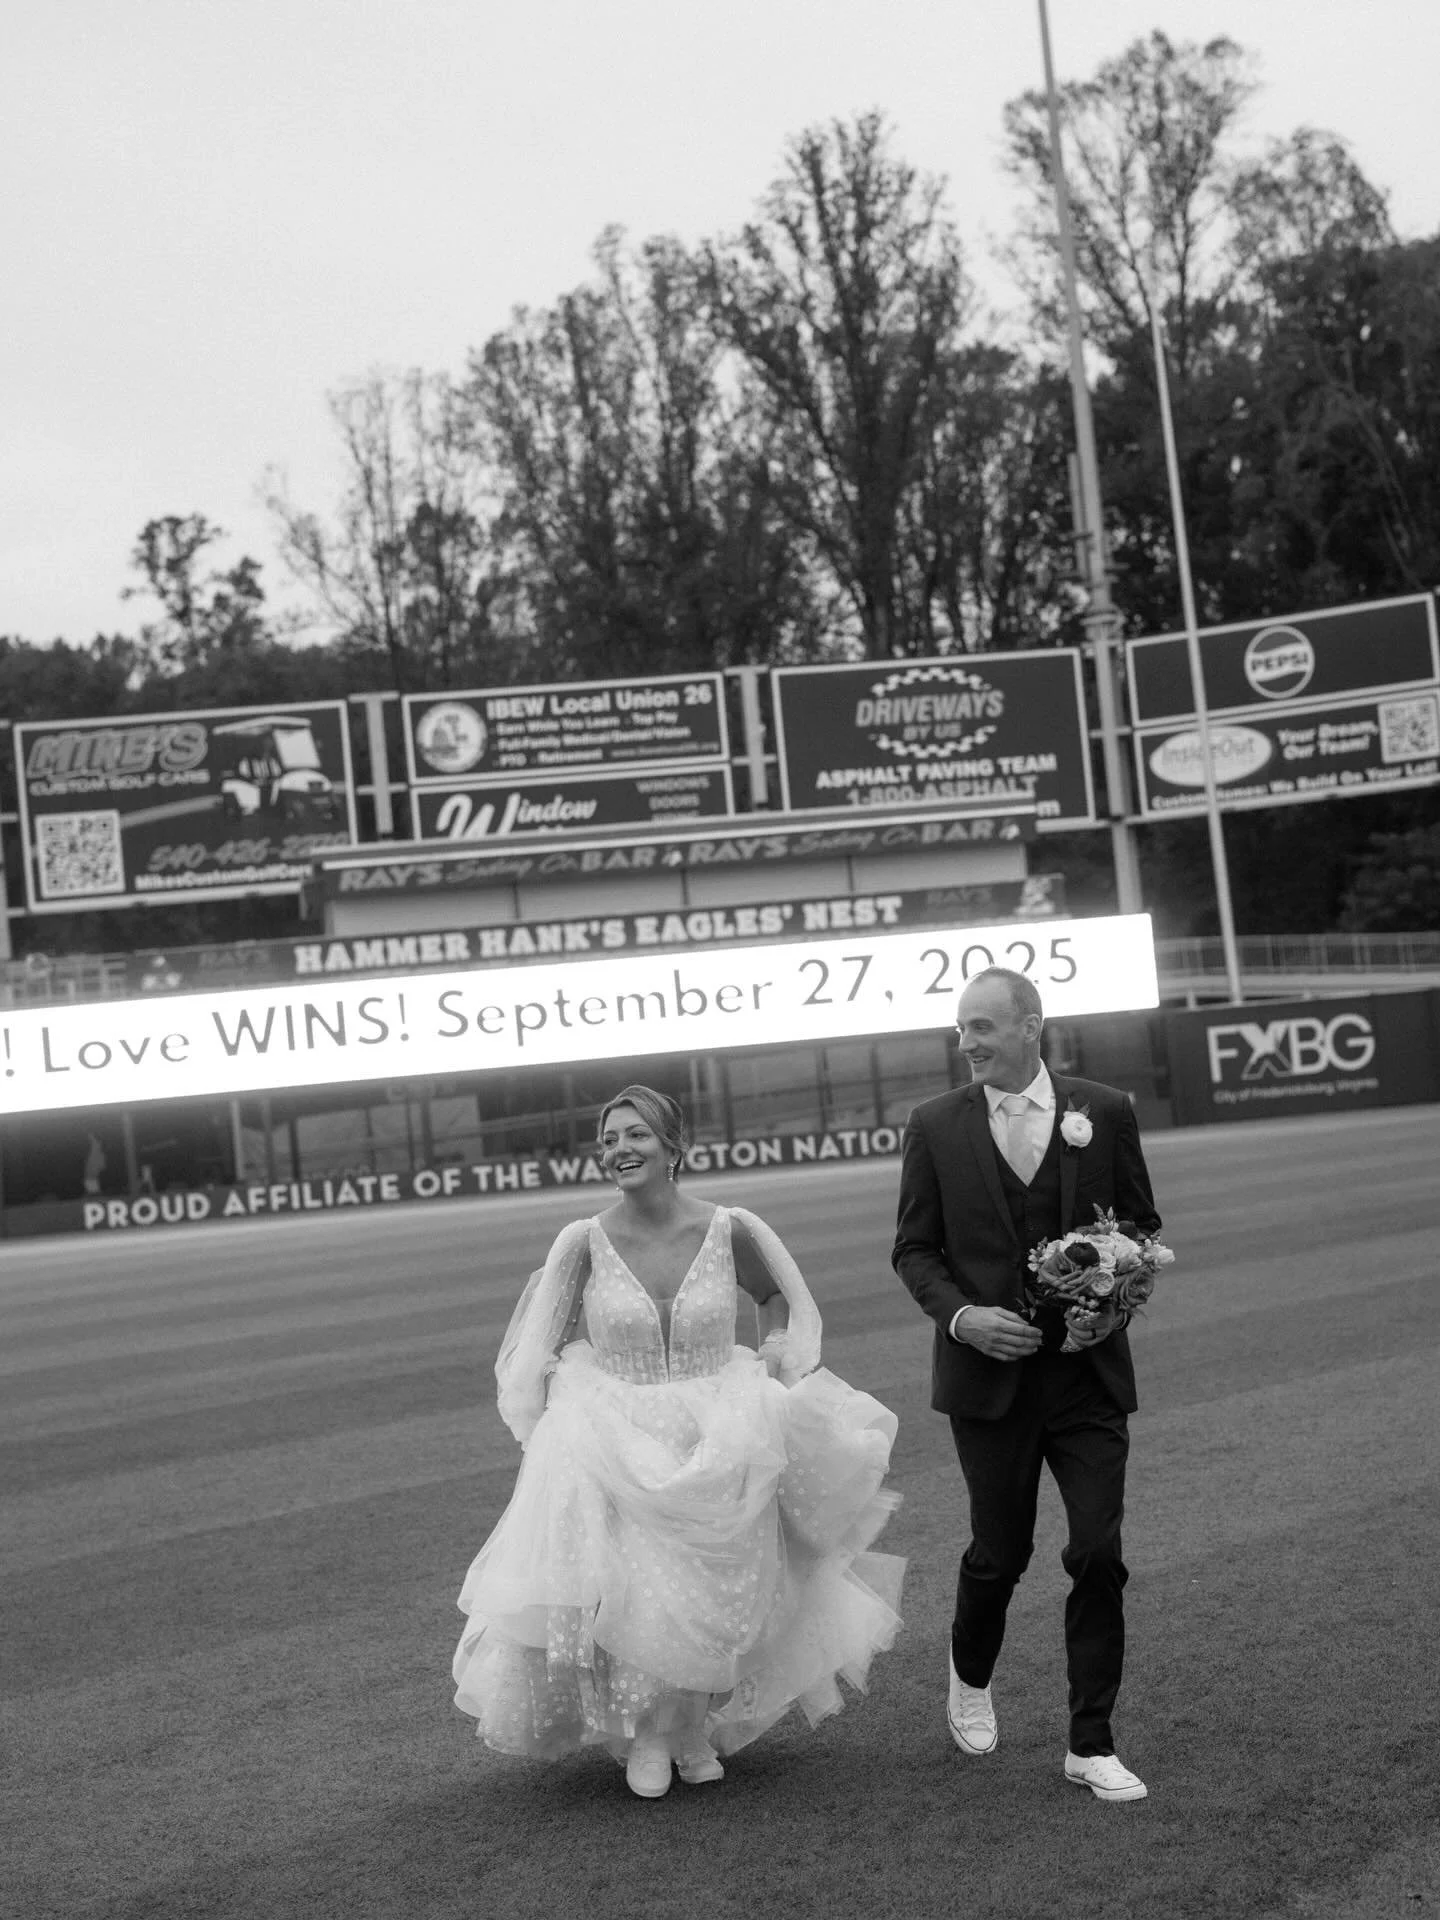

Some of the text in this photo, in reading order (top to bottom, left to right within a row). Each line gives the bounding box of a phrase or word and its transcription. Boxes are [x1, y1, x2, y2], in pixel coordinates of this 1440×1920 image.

[1251, 652, 1309, 673] PEPSI
[486, 683, 713, 721] IBEW Local Union 26
[855, 689, 1005, 728] DRIVEWAYS
[902, 726, 931, 741] BY
[814, 753, 1058, 790] ASPHALT PAVING TEAM
[295, 894, 903, 975] HAMMER HANK'S EAGLES' NEST
[42, 1026, 190, 1074] Love
[212, 993, 412, 1057] WINS!
[437, 969, 774, 1048] September
[798, 953, 895, 1006] 27,
[920, 937, 1078, 996] 2025
[1207, 1013, 1375, 1084] FXBG
[83, 1126, 906, 1232] PROUD AFFILIATE OF THE WAGTON NATIO
